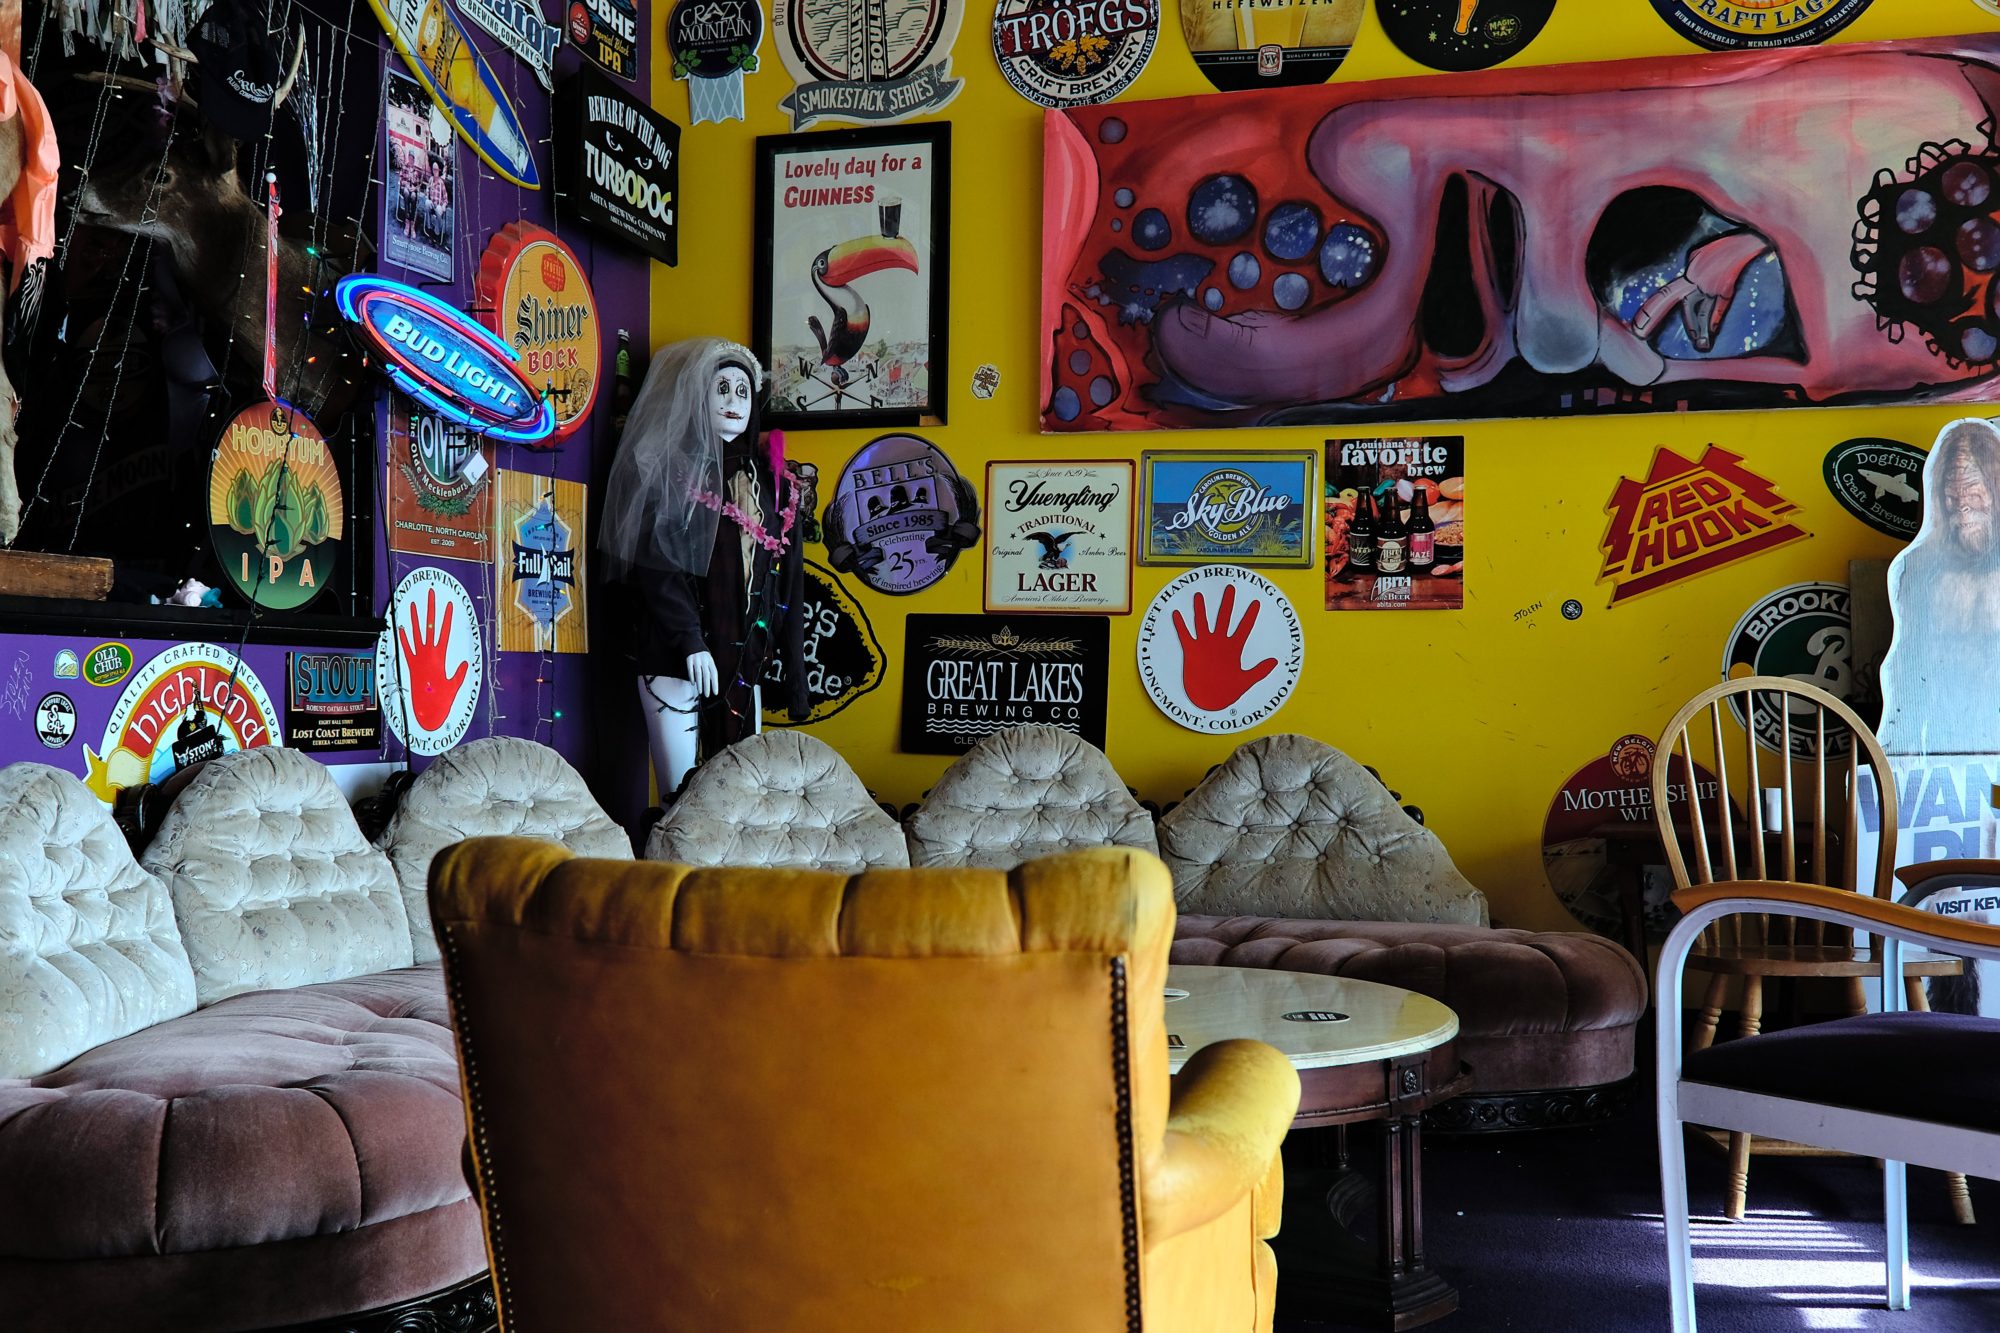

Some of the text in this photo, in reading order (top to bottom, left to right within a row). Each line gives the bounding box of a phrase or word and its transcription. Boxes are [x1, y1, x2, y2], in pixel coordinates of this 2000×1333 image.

[680, 0, 746, 28] CRAZY
[1489, 18, 1516, 31] MAGIC
[467, 0, 534, 59] BREWING COMPANY
[482, 0, 561, 69] ator
[678, 18, 752, 43] MOUNTAIN
[1492, 28, 1513, 37] HAT
[1674, 10, 1697, 30] HUMAN
[1694, 25, 1736, 45] BLOCKHEAD
[1747, 38, 1782, 47] MERMAID
[1783, 29, 1815, 43] PILSNER
[599, 42, 622, 73] IPA
[1002, 57, 1056, 108] HANDCRAFTED
[1058, 100, 1072, 108] BY
[1129, 29, 1157, 81] BROTHERS
[1018, 36, 1141, 96] CRAFT BREWERY
[800, 76, 934, 114] SMOKESTACK SERIES
[588, 96, 673, 171] BEWARE OF THE DOG
[784, 153, 922, 181] Lovely day for a
[584, 140, 673, 226] TURBODOG
[784, 184, 876, 208] GUINNESS
[589, 191, 667, 241] ABITA BREWING COMPANY
[514, 292, 589, 350] Shiner
[383, 313, 517, 405] BUD LIGHT
[526, 346, 579, 375] BOCK
[798, 356, 880, 384] W N
[231, 423, 325, 467] HOPPYUM
[410, 443, 422, 473] Olde
[1340, 442, 1448, 466] favorite
[1355, 440, 1413, 450] Louisiana's
[853, 458, 937, 489] BELL'S
[1407, 462, 1446, 477] brew
[1855, 451, 1919, 473] Dogfish
[1004, 479, 1120, 513] Yuengling
[1199, 473, 1252, 494] CAROLINA BREWERY
[1842, 472, 1868, 503] Craft
[1164, 485, 1292, 532] Sky Blue
[1637, 476, 1732, 533] RED
[394, 520, 489, 541] CHARLOTTE, NORTH CAROLINA
[866, 514, 935, 538] Since 1985
[1017, 514, 1097, 535] TRADITIONAL
[1208, 525, 1252, 541] GOLDEN ALE
[1630, 499, 1773, 576] HOOK
[441, 538, 455, 547] 2009
[878, 532, 926, 548] Celebrating
[991, 546, 1127, 558] Original Amber Beer
[518, 551, 571, 578] Full Sail
[888, 549, 916, 580] 25
[527, 588, 551, 598] BREWING
[871, 575, 881, 584] of
[882, 578, 913, 592] inspired
[1017, 572, 1098, 592] LAGER
[1371, 576, 1411, 600] ABITA
[1002, 594, 1042, 604] America's
[1042, 594, 1069, 603] Oldest
[1513, 600, 1543, 621] STOLEN
[412, 569, 484, 675] BREWING COMPANY
[1142, 567, 1302, 678] LEFT HAND BREWING COMPANY
[93, 657, 123, 675] CHUB
[95, 647, 118, 663] OLD
[297, 654, 374, 697] STOUT
[926, 659, 1084, 704] GREAT LAKES
[109, 664, 157, 735] QUALITY
[163, 644, 221, 665] CRAFTED
[226, 655, 260, 694] SNCE
[259, 697, 280, 740] 1994
[1141, 655, 1290, 731] LONGMONT, COLORADO
[306, 703, 365, 712] ROBUST OATMEAL STOUT
[432, 689, 478, 751] COLORADO
[927, 703, 1081, 719] BREWING CO.
[292, 727, 375, 739] LOST COAST BREWERY
[1613, 738, 1654, 762] NEW BELGIU
[1936, 899, 1971, 915] VISIT
